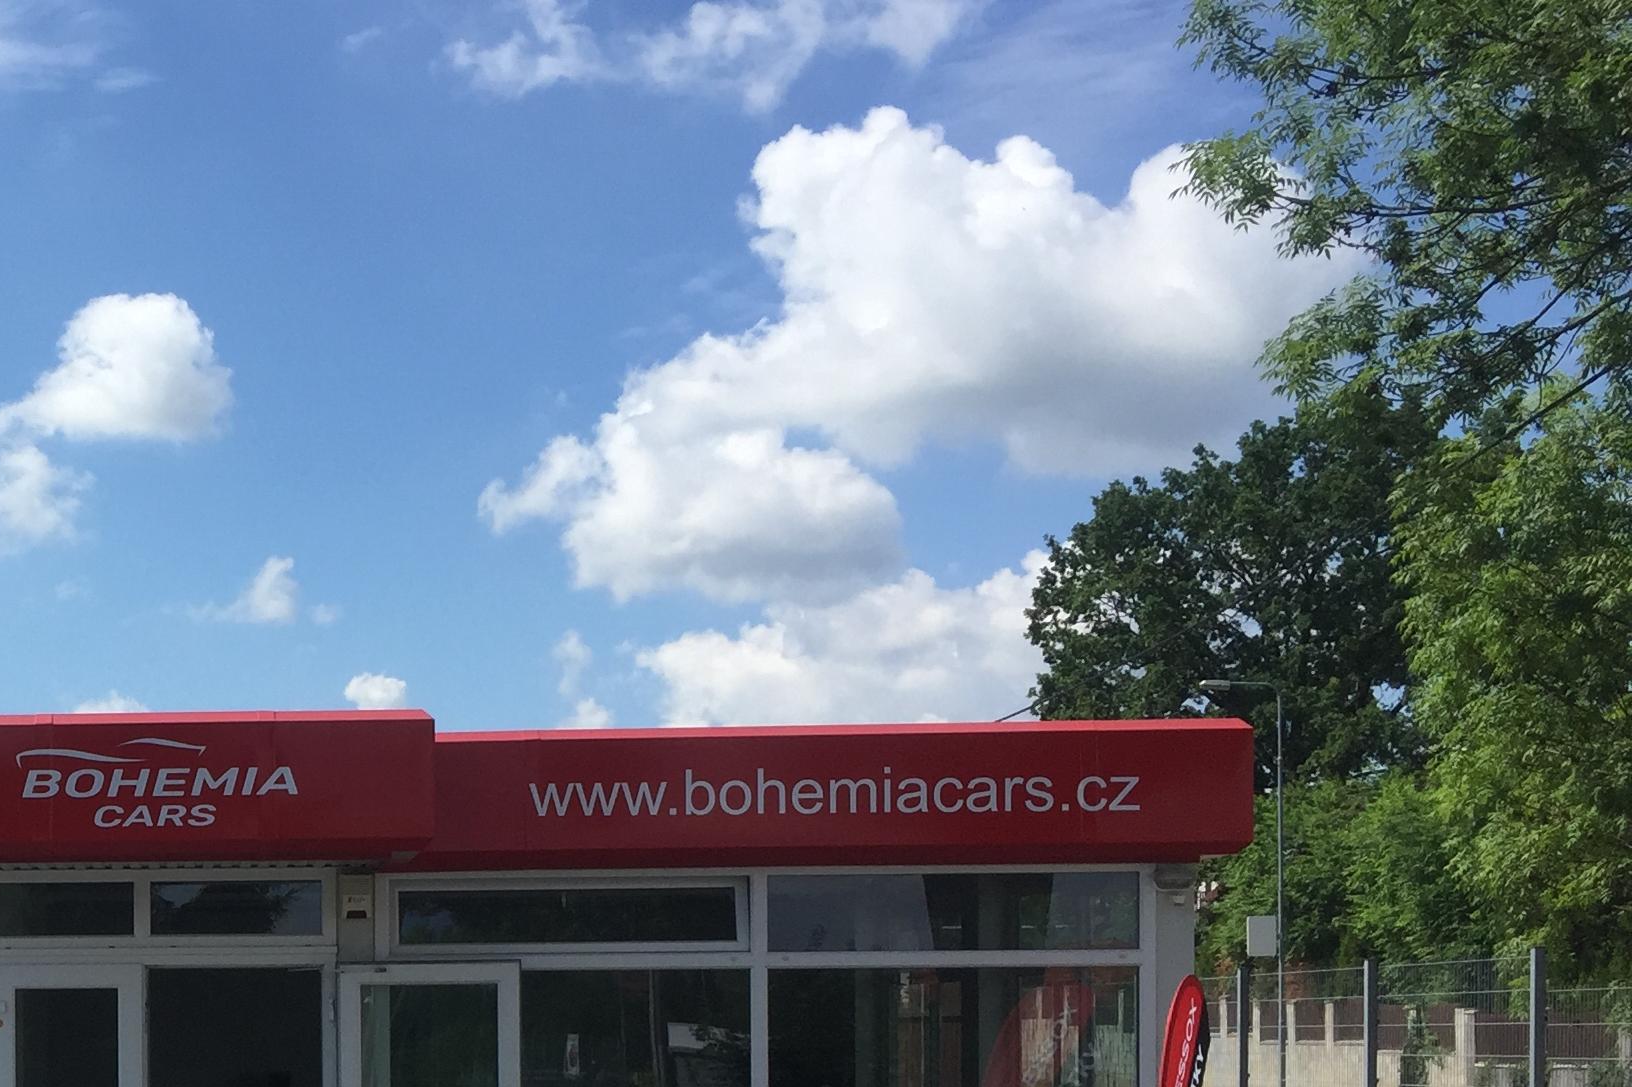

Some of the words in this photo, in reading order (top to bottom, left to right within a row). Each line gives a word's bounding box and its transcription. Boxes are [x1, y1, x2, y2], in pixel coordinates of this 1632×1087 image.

[22, 766, 299, 799] BOHEMIA
[528, 766, 1141, 818] www.bohemiacars.cz
[94, 804, 217, 828] CARS
